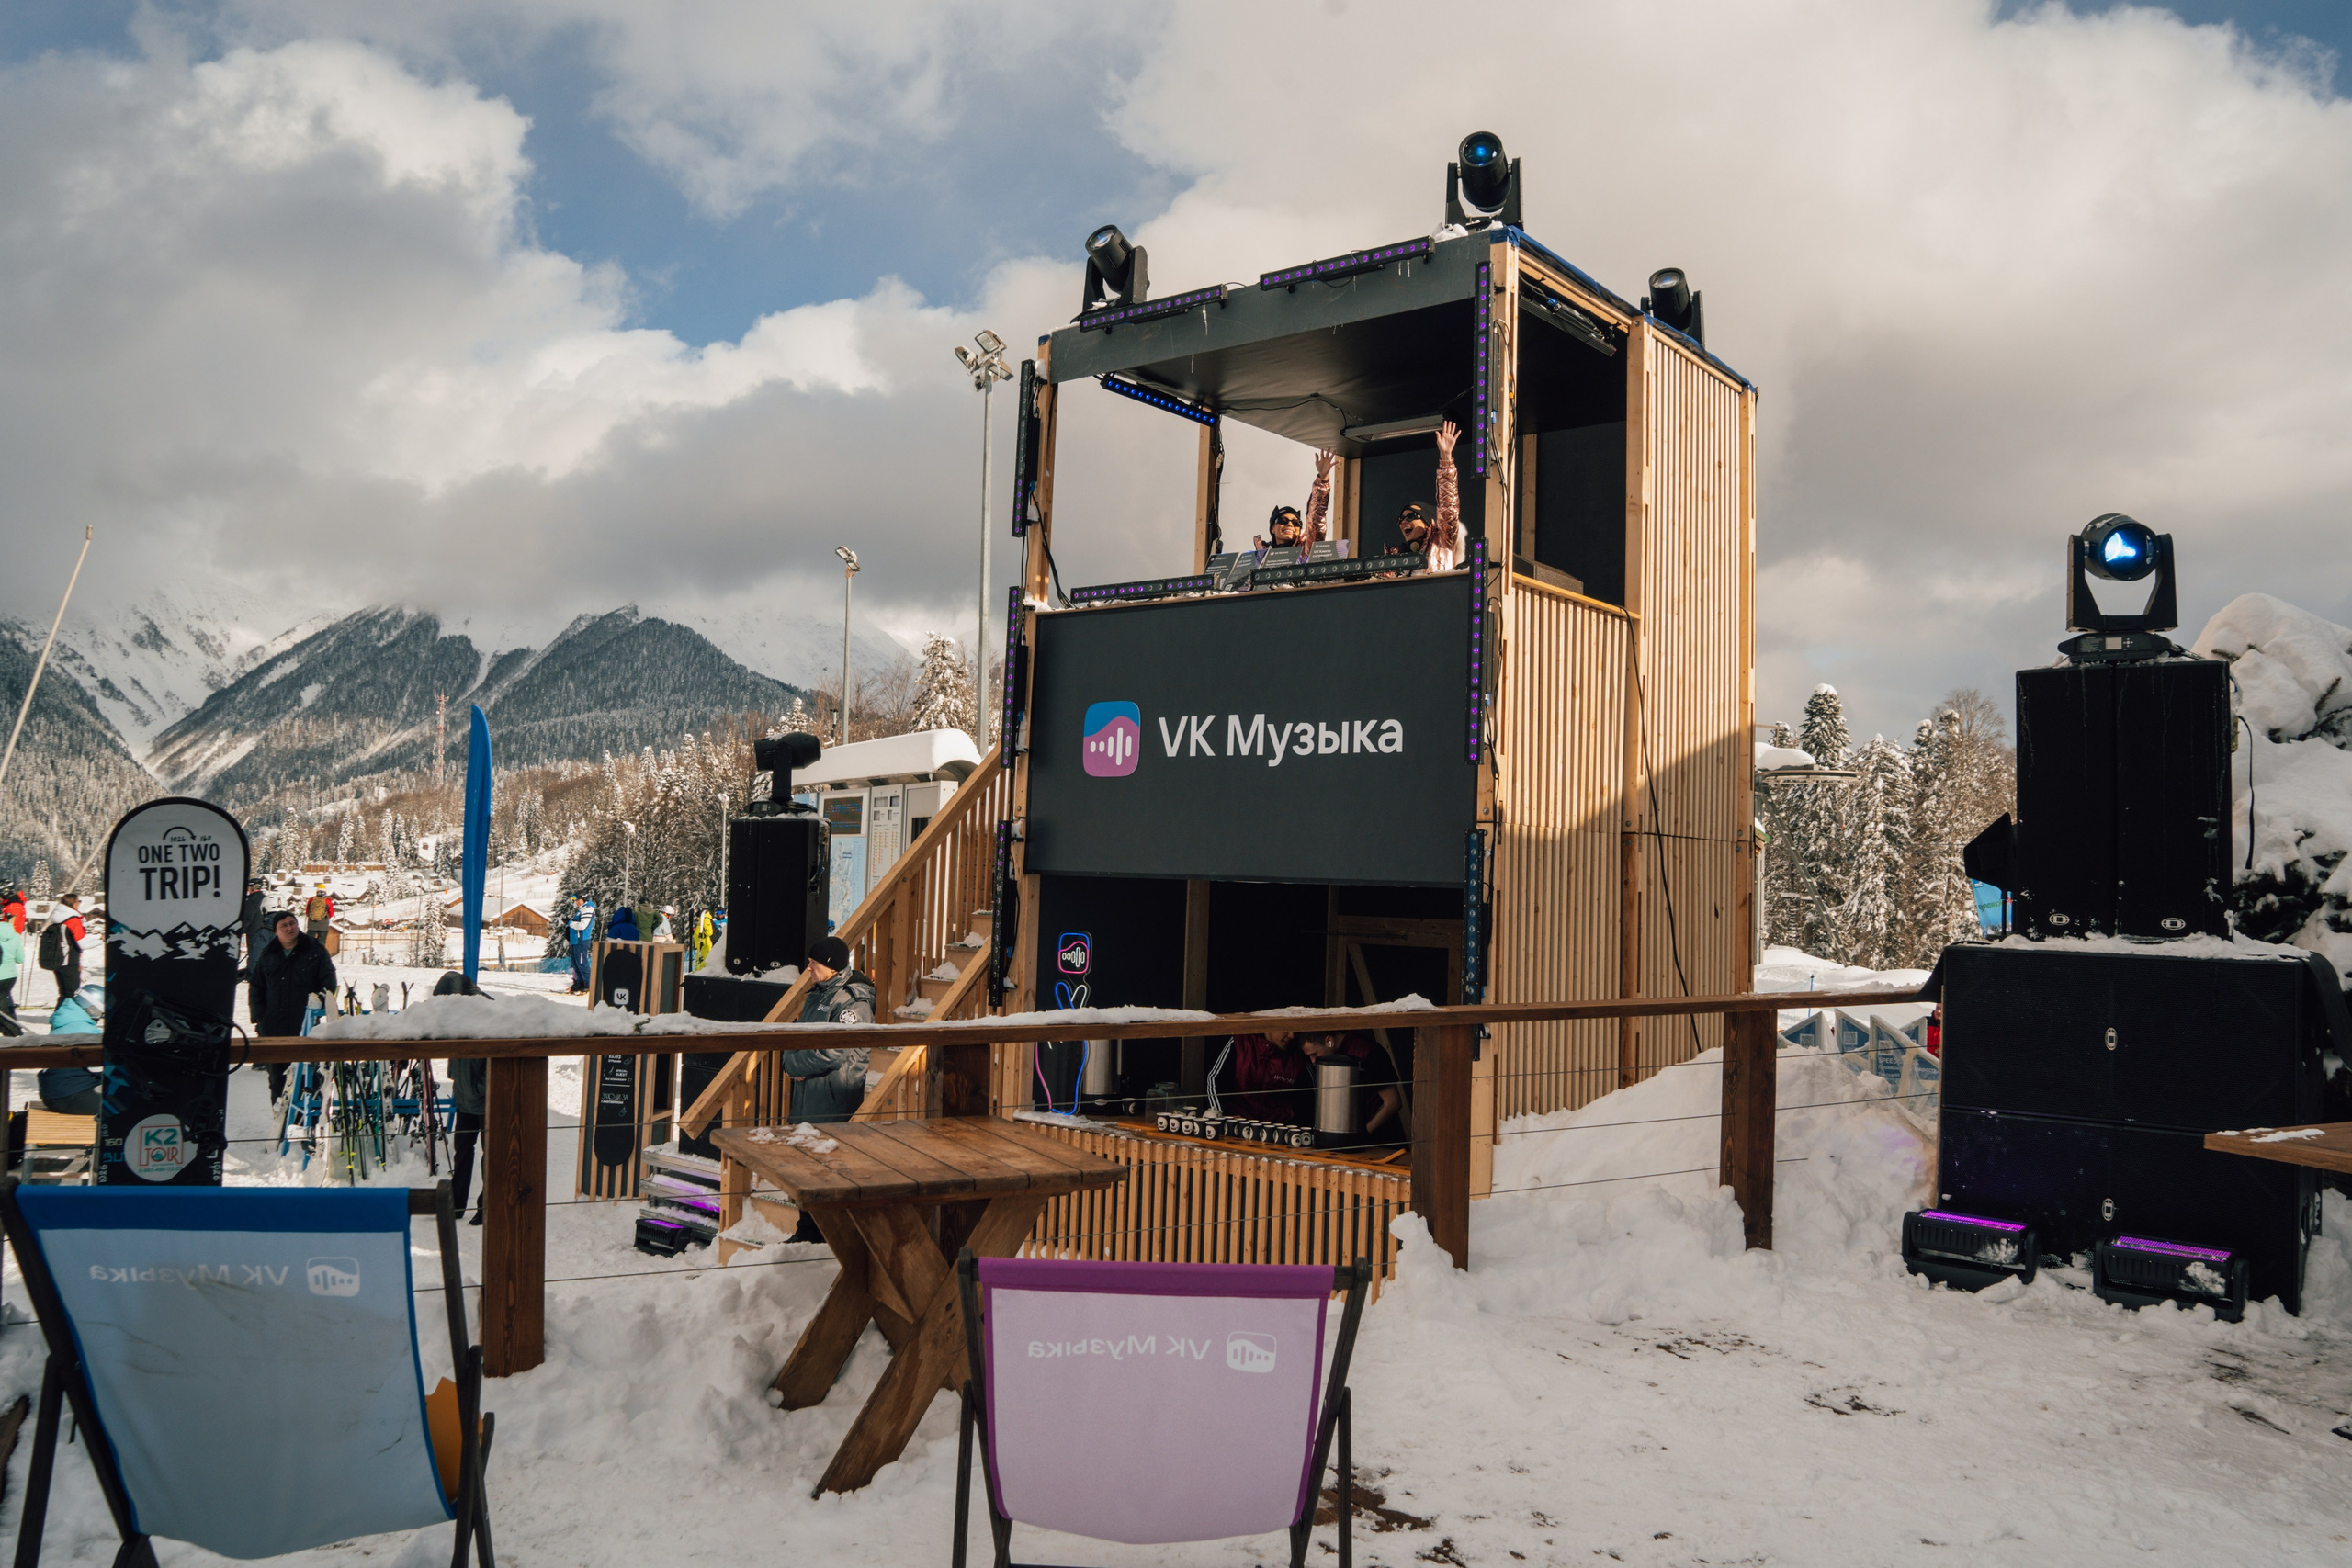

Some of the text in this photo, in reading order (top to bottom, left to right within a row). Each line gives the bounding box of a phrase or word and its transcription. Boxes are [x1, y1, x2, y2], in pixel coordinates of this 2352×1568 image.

[1159, 714, 1404, 767] VK Музыка
[138, 843, 220, 863] ONE TWO
[139, 864, 221, 901] TRIP!
[616, 993, 627, 1001] VK
[622, 1093, 628, 1101] ЗА
[144, 1128, 178, 1146] K2
[144, 1147, 179, 1162] TOUR
[98, 1164, 107, 1183] 1026
